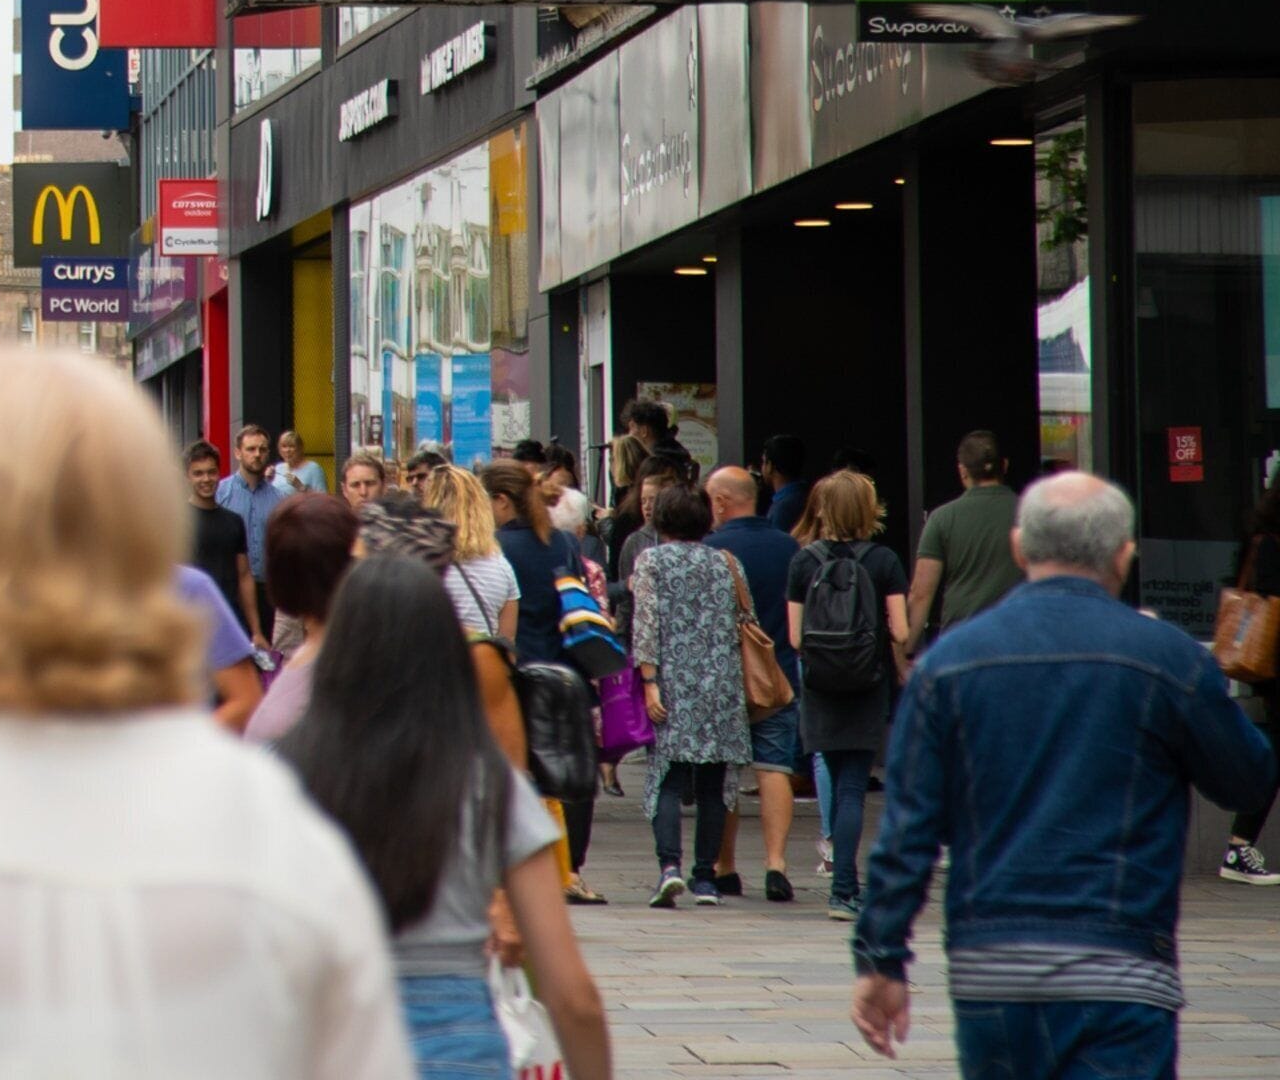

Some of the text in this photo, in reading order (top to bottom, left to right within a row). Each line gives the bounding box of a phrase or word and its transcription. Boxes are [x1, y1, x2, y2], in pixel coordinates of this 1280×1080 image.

[183, 209, 212, 217] outdoor
[53, 263, 116, 284] currys
[49, 297, 72, 314] PC
[74, 297, 120, 314] World
[1175, 435, 1198, 448] 15%
